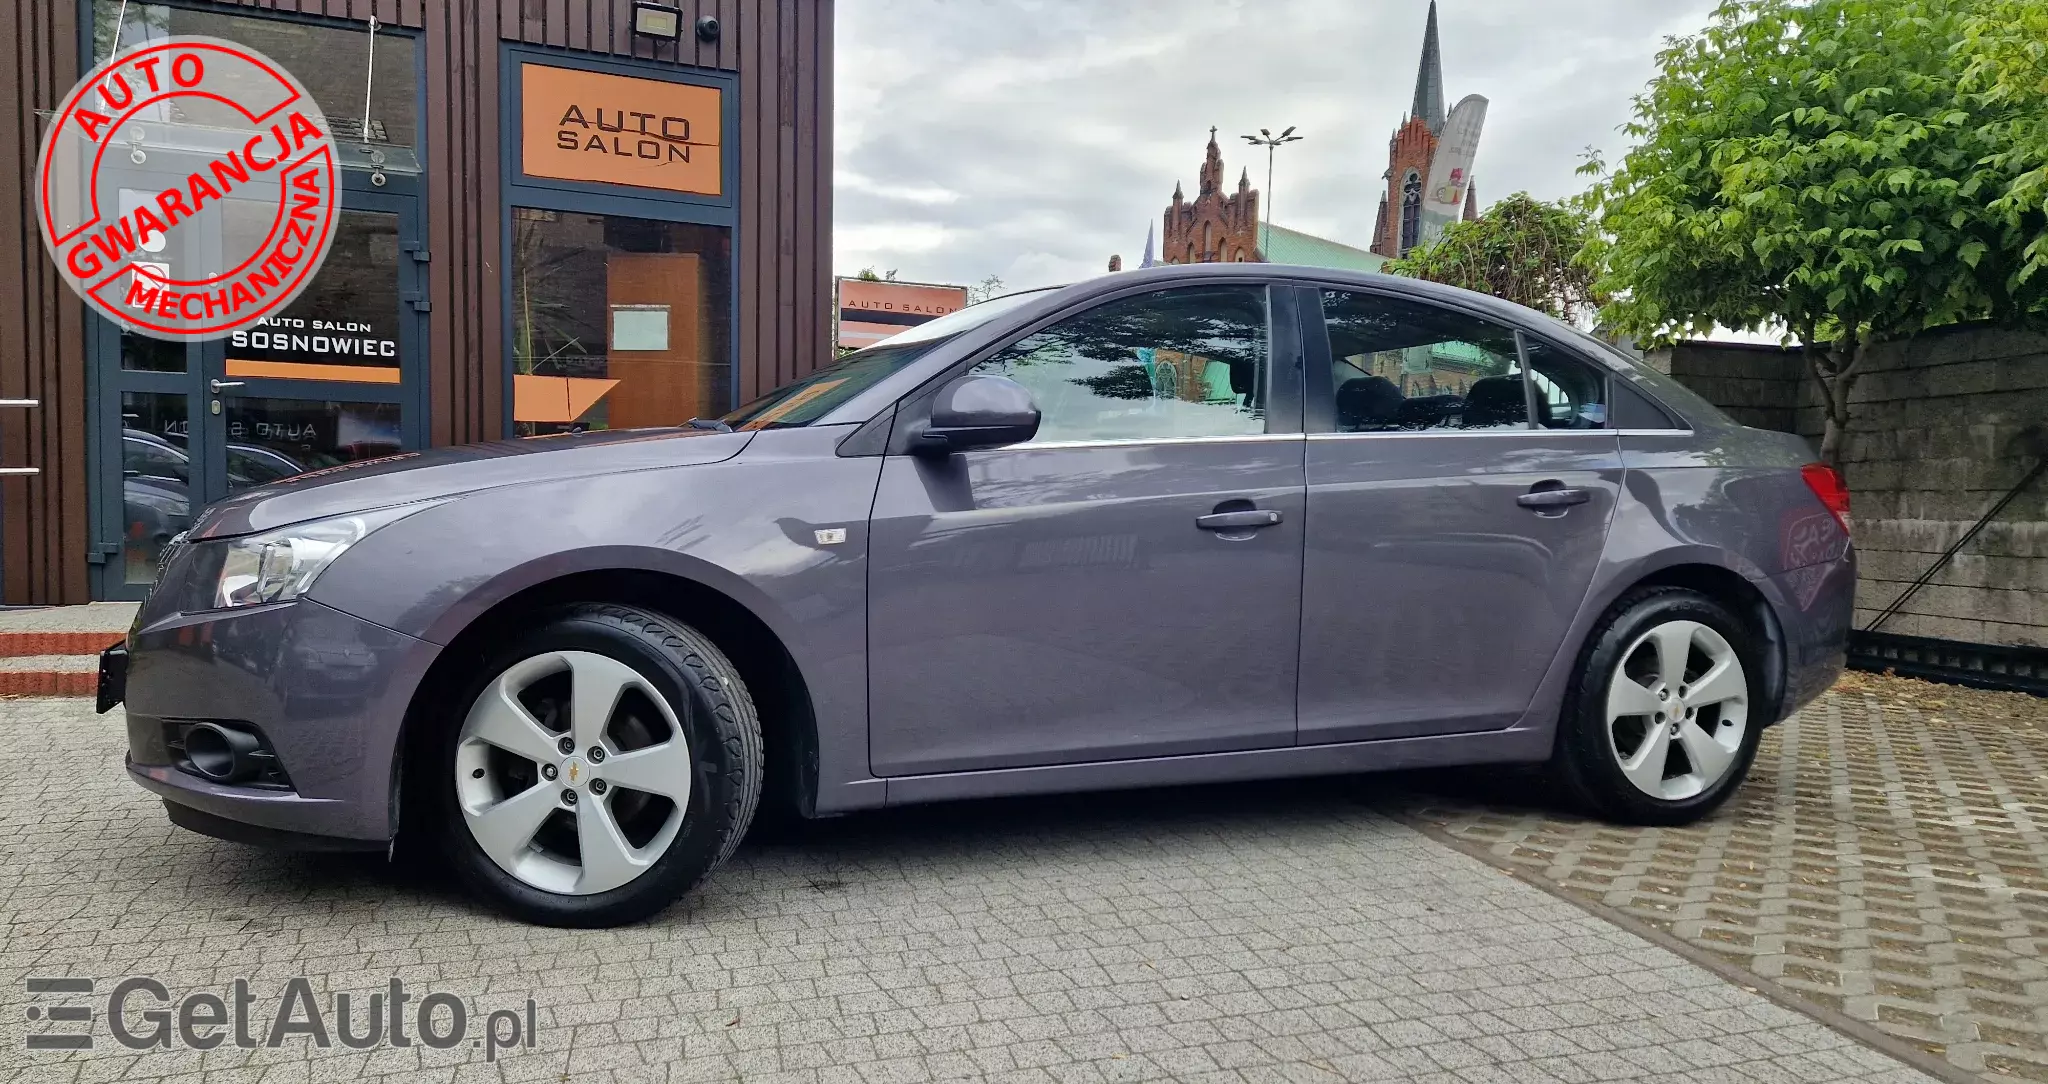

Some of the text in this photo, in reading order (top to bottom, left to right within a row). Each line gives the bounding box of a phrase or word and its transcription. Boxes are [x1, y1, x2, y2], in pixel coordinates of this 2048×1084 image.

[558, 104, 690, 141] AUTO
[557, 130, 691, 164] SALON
[849, 299, 958, 314] AUTO SALON
[256, 316, 372, 333] AUTO SALON
[231, 330, 396, 358] SOSNOWIEC
